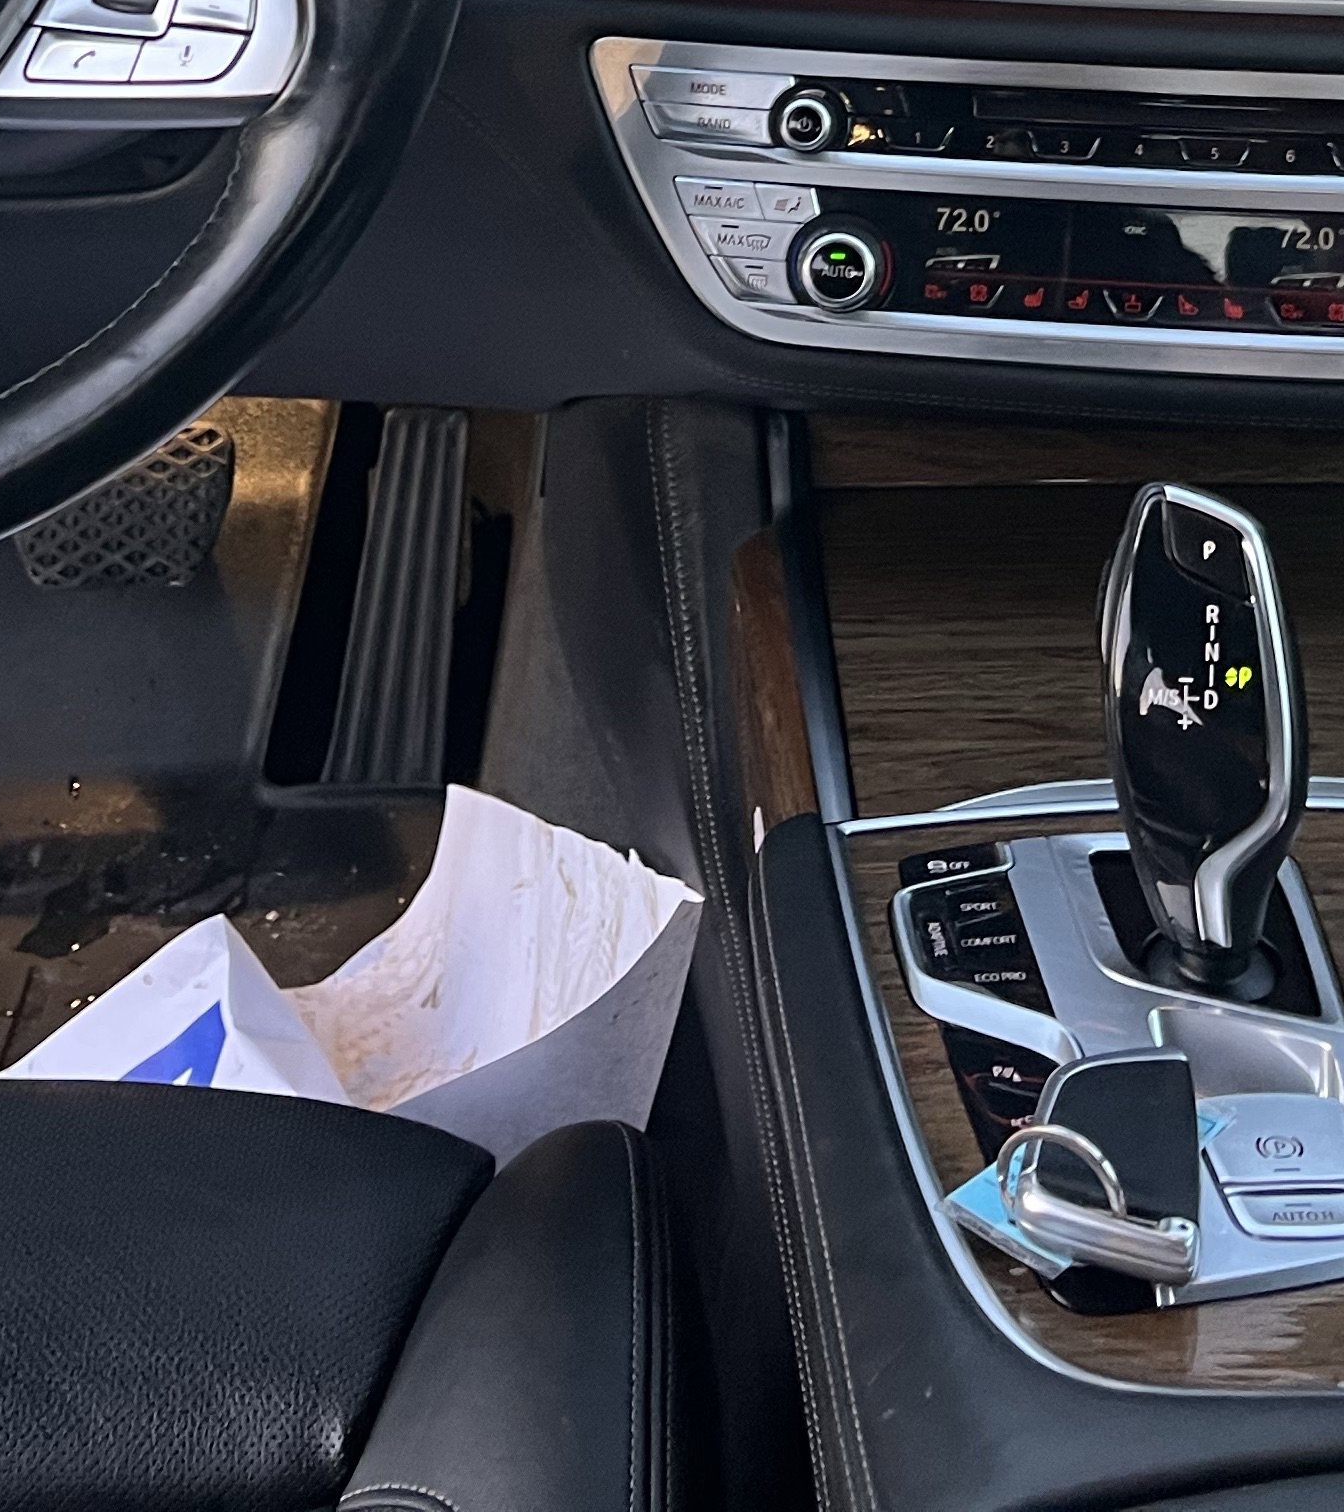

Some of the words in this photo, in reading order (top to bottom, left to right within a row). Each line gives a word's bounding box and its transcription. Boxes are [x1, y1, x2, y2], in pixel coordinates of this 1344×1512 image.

[689, 82, 727, 96] MODE
[914, 131, 922, 145] 1
[985, 135, 995, 149] 2
[1060, 140, 1070, 154] 3
[1134, 143, 1144, 156] 4
[1210, 146, 1220, 160] 5
[1285, 149, 1296, 163] 6
[1202, 539, 1217, 560] P
[1205, 604, 1220, 624] R
[1205, 641, 1220, 662] N
[1203, 689, 1219, 710] D
[959, 901, 998, 912] SPORT
[960, 934, 1017, 948] COMFORT
[974, 973, 1000, 983] ECO
[1001, 971, 1027, 982] PRO
